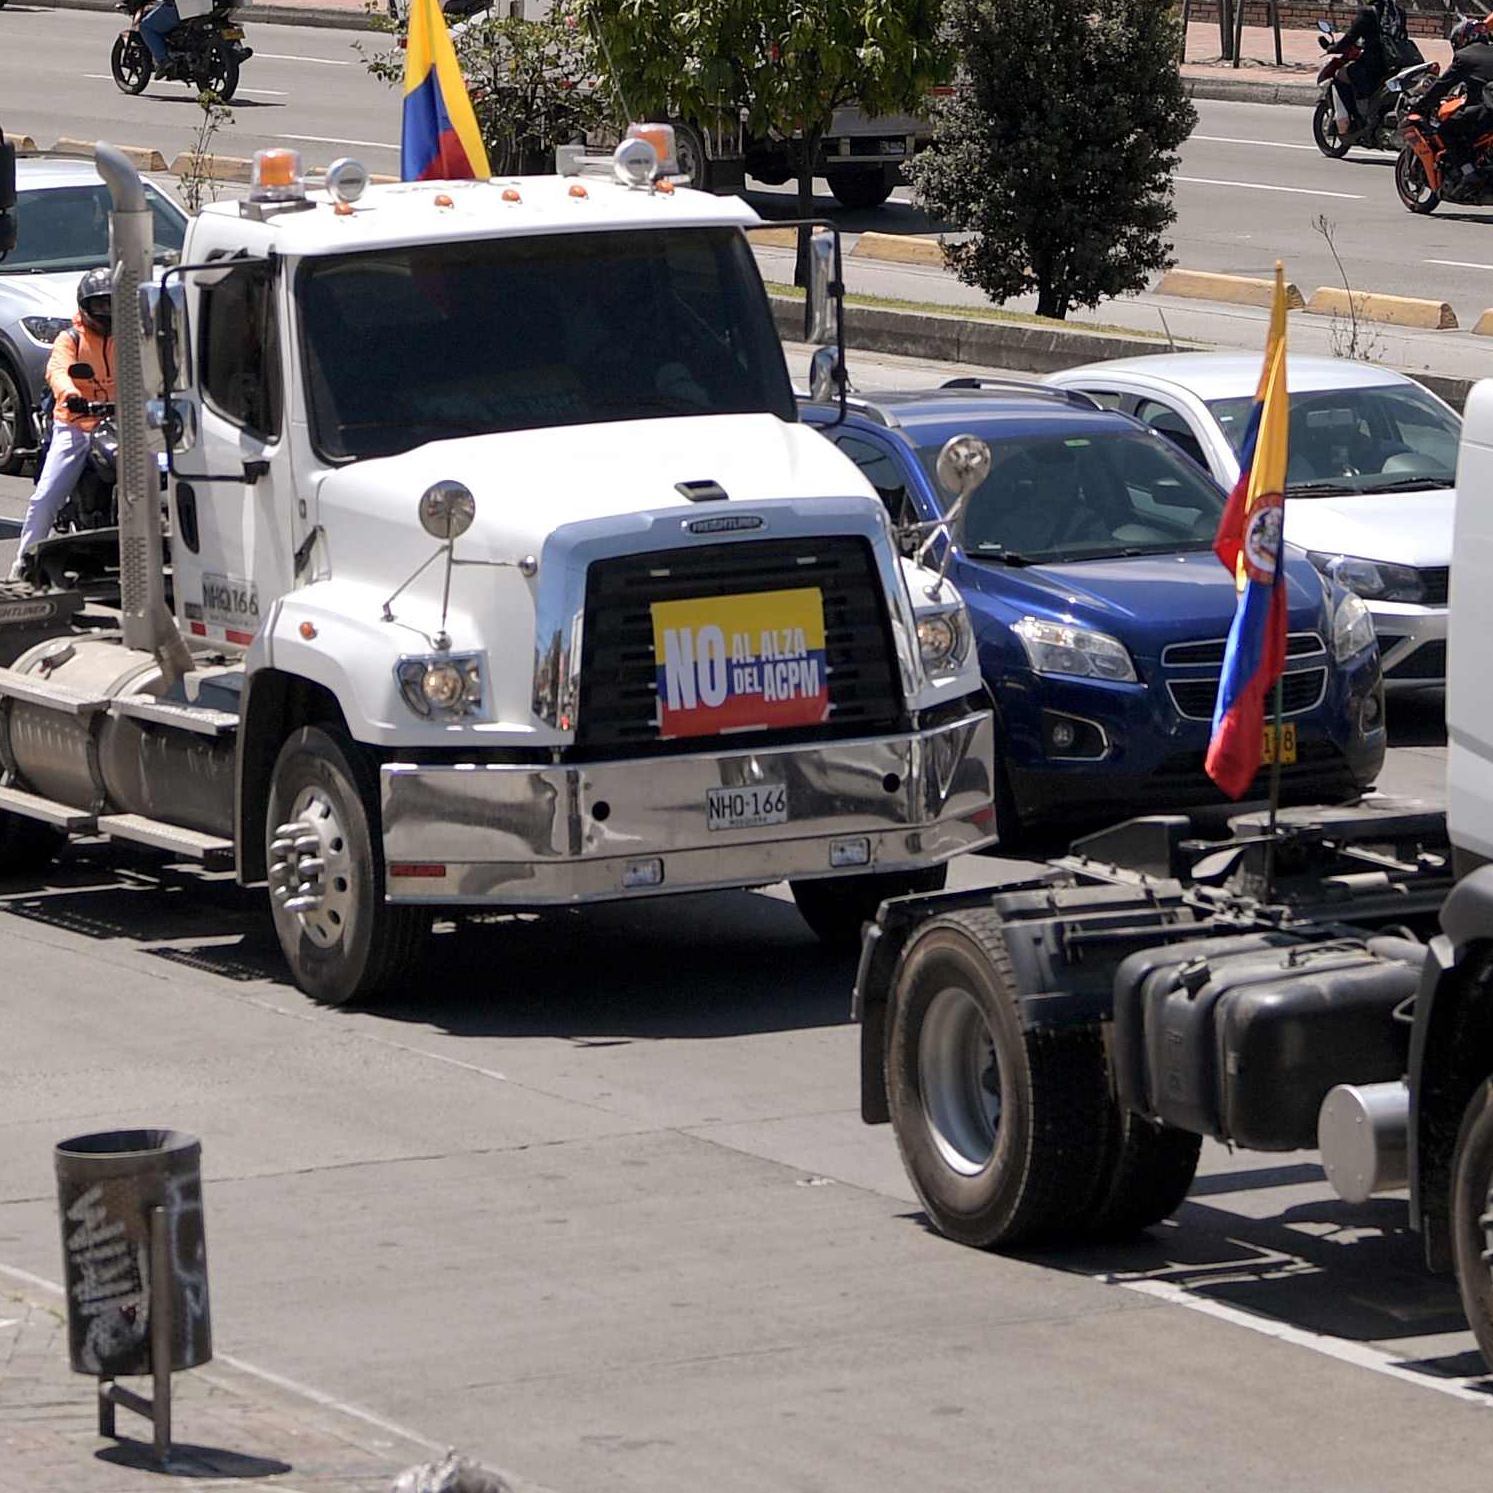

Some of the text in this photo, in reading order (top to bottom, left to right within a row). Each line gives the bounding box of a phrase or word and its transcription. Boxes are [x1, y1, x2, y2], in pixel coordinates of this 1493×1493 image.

[663, 624, 728, 711] NO
[731, 627, 808, 665] AL ALZA
[732, 659, 820, 702] DEL ACPM
